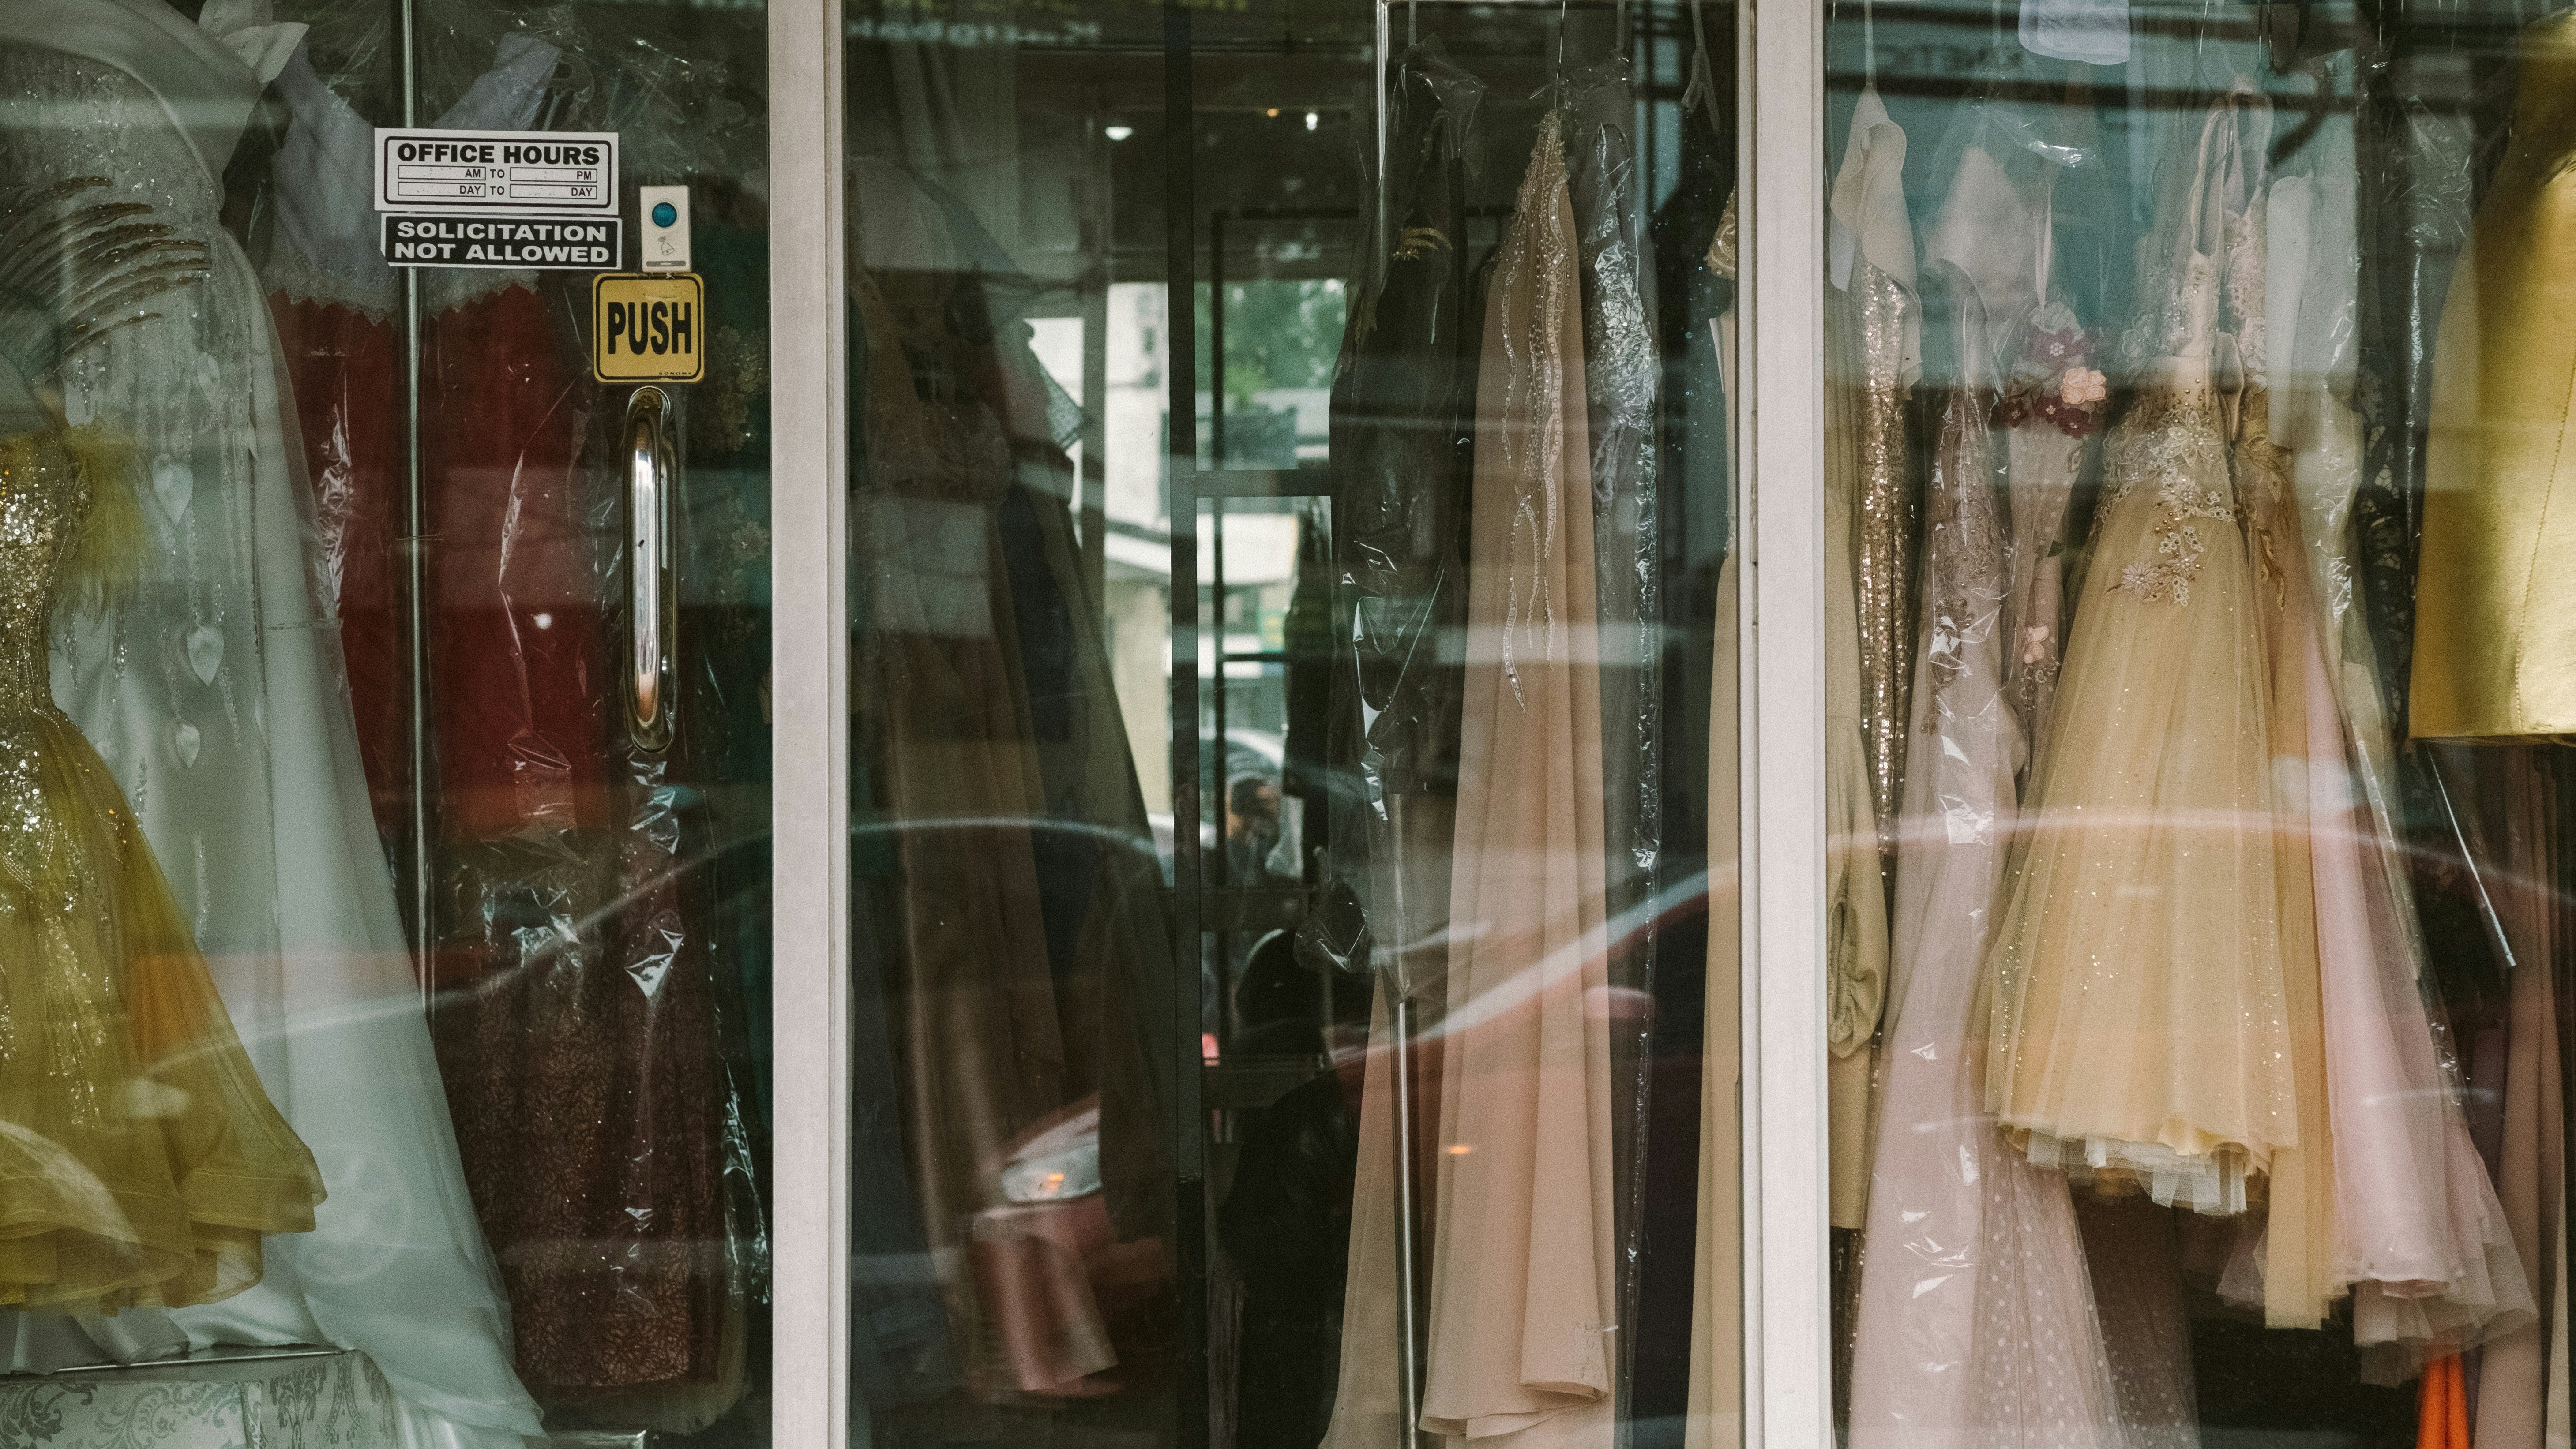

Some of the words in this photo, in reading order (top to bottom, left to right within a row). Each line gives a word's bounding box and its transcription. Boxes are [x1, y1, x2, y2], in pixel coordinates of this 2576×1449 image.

[397, 143, 494, 163] OFFICE
[504, 146, 600, 165] HOURS
[465, 168, 481, 178] AM
[490, 169, 505, 179] TO
[577, 171, 592, 180] PM
[459, 185, 481, 195] DAY
[490, 186, 505, 195] TO
[571, 187, 593, 197] DAY
[398, 222, 606, 241] SOLICITATION
[395, 243, 456, 259] NOT
[466, 244, 609, 262] ALLOWED
[608, 302, 692, 355] PUSH
